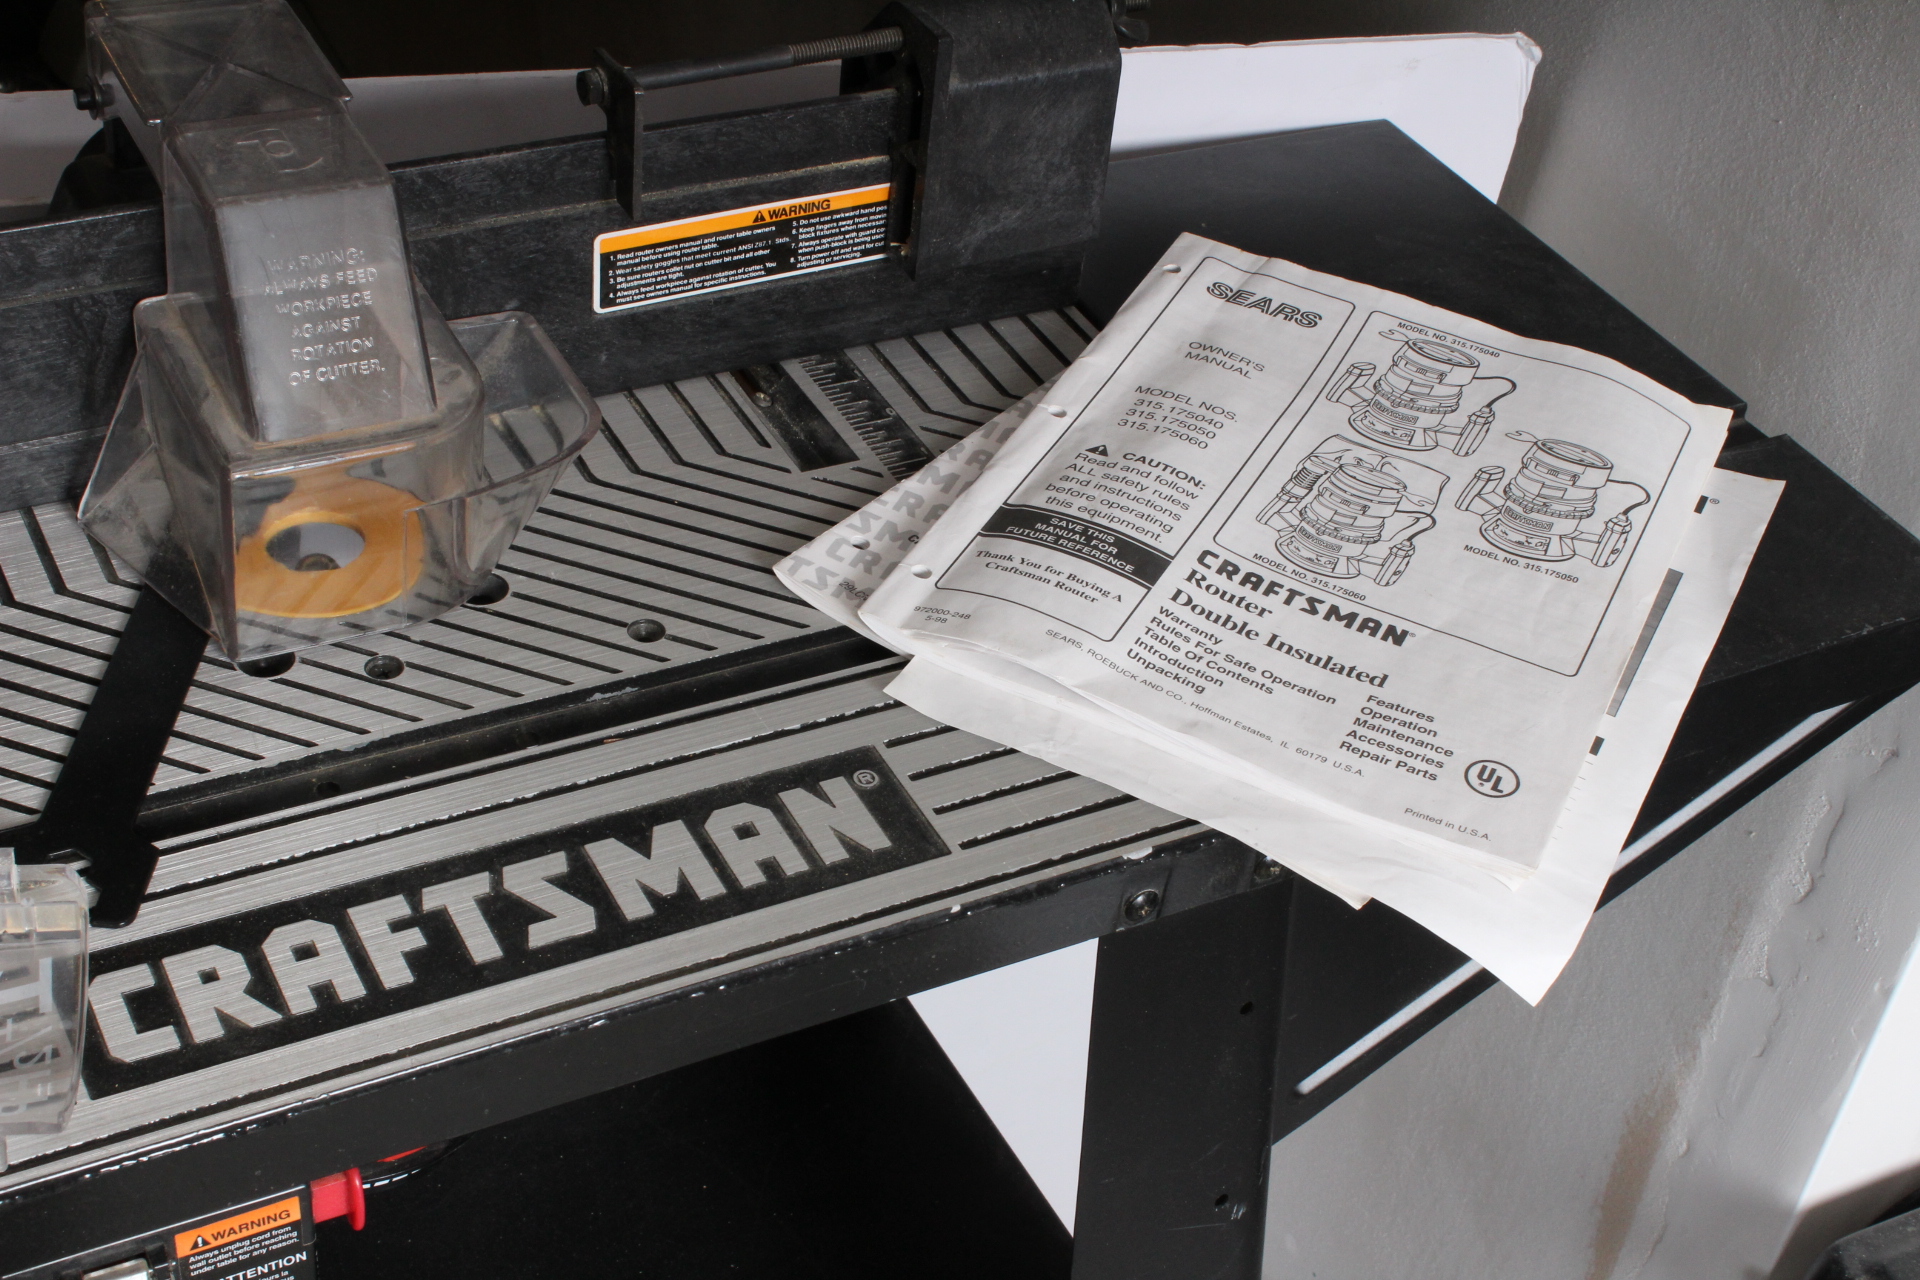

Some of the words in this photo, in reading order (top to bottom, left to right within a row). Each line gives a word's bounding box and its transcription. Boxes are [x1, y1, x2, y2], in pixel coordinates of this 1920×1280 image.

[768, 200, 830, 220] WARNING
[266, 247, 366, 272] WARNING:
[616, 252, 634, 260] Read
[635, 248, 654, 256] router
[655, 244, 678, 252] owners
[679, 239, 702, 248] manual
[716, 233, 736, 241] router
[736, 229, 752, 237] table
[753, 226, 776, 234] owners
[616, 258, 640, 266] manual
[642, 253, 662, 262] before
[664, 250, 680, 258] using
[682, 246, 700, 254] router
[633, 264, 653, 272] safety
[654, 259, 680, 269] goggles
[695, 252, 712, 260] meet
[712, 248, 736, 256] current
[738, 244, 754, 252] ANSI
[796, 258, 825, 268] adjusting
[832, 252, 862, 260] servicing.
[264, 273, 331, 296] ALWAYS
[336, 266, 378, 285] FEED
[616, 278, 656, 290] adjustments
[668, 272, 684, 280] tight.
[642, 270, 664, 278] routers
[666, 266, 683, 274] collet
[704, 258, 722, 266] cutter
[754, 248, 770, 256] other
[275, 290, 372, 316] WORKPIECE
[1206, 281, 1322, 328] SEARS
[291, 315, 361, 338] AGAINST
[1398, 322, 1430, 338] MODEL
[1432, 333, 1448, 343] NO.
[291, 336, 374, 362] ROTATION
[1184, 352, 1252, 380] MANUAL
[1188, 341, 1265, 372] OWNER'S
[288, 369, 311, 386] OF
[316, 358, 386, 382] CUTTER.
[1134, 386, 1194, 406] MODEL
[1198, 402, 1238, 422] NOS.
[1134, 398, 1224, 429] 315.175040
[1118, 418, 1208, 450] 315.175060
[1126, 408, 1216, 439] 315.175050
[1065, 463, 1096, 477] ALL
[1101, 471, 1149, 492] safety
[1152, 488, 1190, 511] rules
[1074, 452, 1118, 469] Read
[1120, 464, 1152, 479] and
[1154, 475, 1200, 500] follow
[1122, 452, 1206, 490] CAUTION:
[1045, 483, 1096, 502] before
[1100, 498, 1174, 534] operating
[1059, 474, 1090, 488] and
[1093, 482, 1182, 522] instructions
[1046, 495, 1074, 509] this
[1078, 506, 1162, 544] equipment.
[1050, 517, 1085, 532] SAVE
[1088, 528, 1116, 543] THIS
[1005, 526, 1058, 543] FUTURE
[1058, 539, 1135, 573] REFERENCE
[1035, 522, 1087, 543] MANUAL
[1090, 540, 1118, 554] FOR
[974, 550, 1016, 564] Thank
[1019, 556, 1042, 570] You
[1044, 565, 1064, 577] for
[1066, 573, 1111, 598] Buying
[1112, 594, 1122, 602] A
[985, 560, 1051, 585] Craftsman
[1054, 580, 1098, 603] Router
[1252, 553, 1288, 574] MODEL
[1290, 568, 1309, 582] NO.
[1310, 576, 1367, 602] 315.175060
[1464, 544, 1500, 562] MODEL
[1502, 556, 1521, 568] NO.
[1522, 562, 1579, 584] 315.175050
[1183, 568, 1274, 618] Router
[1196, 549, 1410, 648] CRAFTSMAN
[914, 605, 972, 620] 972000-248
[924, 614, 948, 624] 5-98
[1158, 606, 1223, 646] Warranty
[1168, 587, 1260, 641] Double
[1263, 632, 1389, 689] Insulated
[1126, 648, 1206, 696] Unpacking
[1134, 637, 1224, 688] Introduction
[1144, 626, 1182, 652] Table
[1184, 650, 1204, 662] Of
[1206, 659, 1275, 696] Contents
[1149, 616, 1191, 644] Rules
[1194, 640, 1221, 657] For
[1223, 654, 1257, 673] Safe
[1260, 670, 1337, 705] Operation
[1045, 629, 1084, 651] SEARS,
[1086, 647, 1138, 682] ROEBUCK
[1140, 678, 1164, 692] AND
[1190, 700, 1233, 724] Hoffman
[1234, 720, 1274, 743] Estates,
[1279, 740, 1290, 750] IL
[1294, 747, 1328, 764] 60179
[1332, 760, 1366, 778] U.S.A.
[1366, 694, 1436, 723] Features
[1352, 718, 1454, 758] Maintenance
[1360, 706, 1438, 738] Operation
[1338, 740, 1392, 766] Repair
[1395, 760, 1438, 782] Parts
[1346, 730, 1445, 769] Accessories
[1476, 764, 1504, 794] UL
[1404, 808, 1443, 826] Printed
[1444, 820, 1455, 830] in
[1458, 824, 1492, 842] U.S.A.
[88, 776, 893, 1064] CRAFTSMAN
[211, 1210, 290, 1241] WARNING
[188, 1250, 219, 1263] Always
[221, 1240, 250, 1254] unplug
[252, 1232, 270, 1242] cord
[272, 1226, 292, 1236] from
[190, 1260, 206, 1270] wall
[208, 1252, 232, 1264] outlet
[234, 1244, 260, 1256] before
[262, 1231, 298, 1246] reaching
[190, 1265, 215, 1276] under
[217, 1257, 238, 1268] table
[239, 1251, 250, 1260] for
[252, 1248, 268, 1258] any
[269, 1238, 300, 1250] reason.
